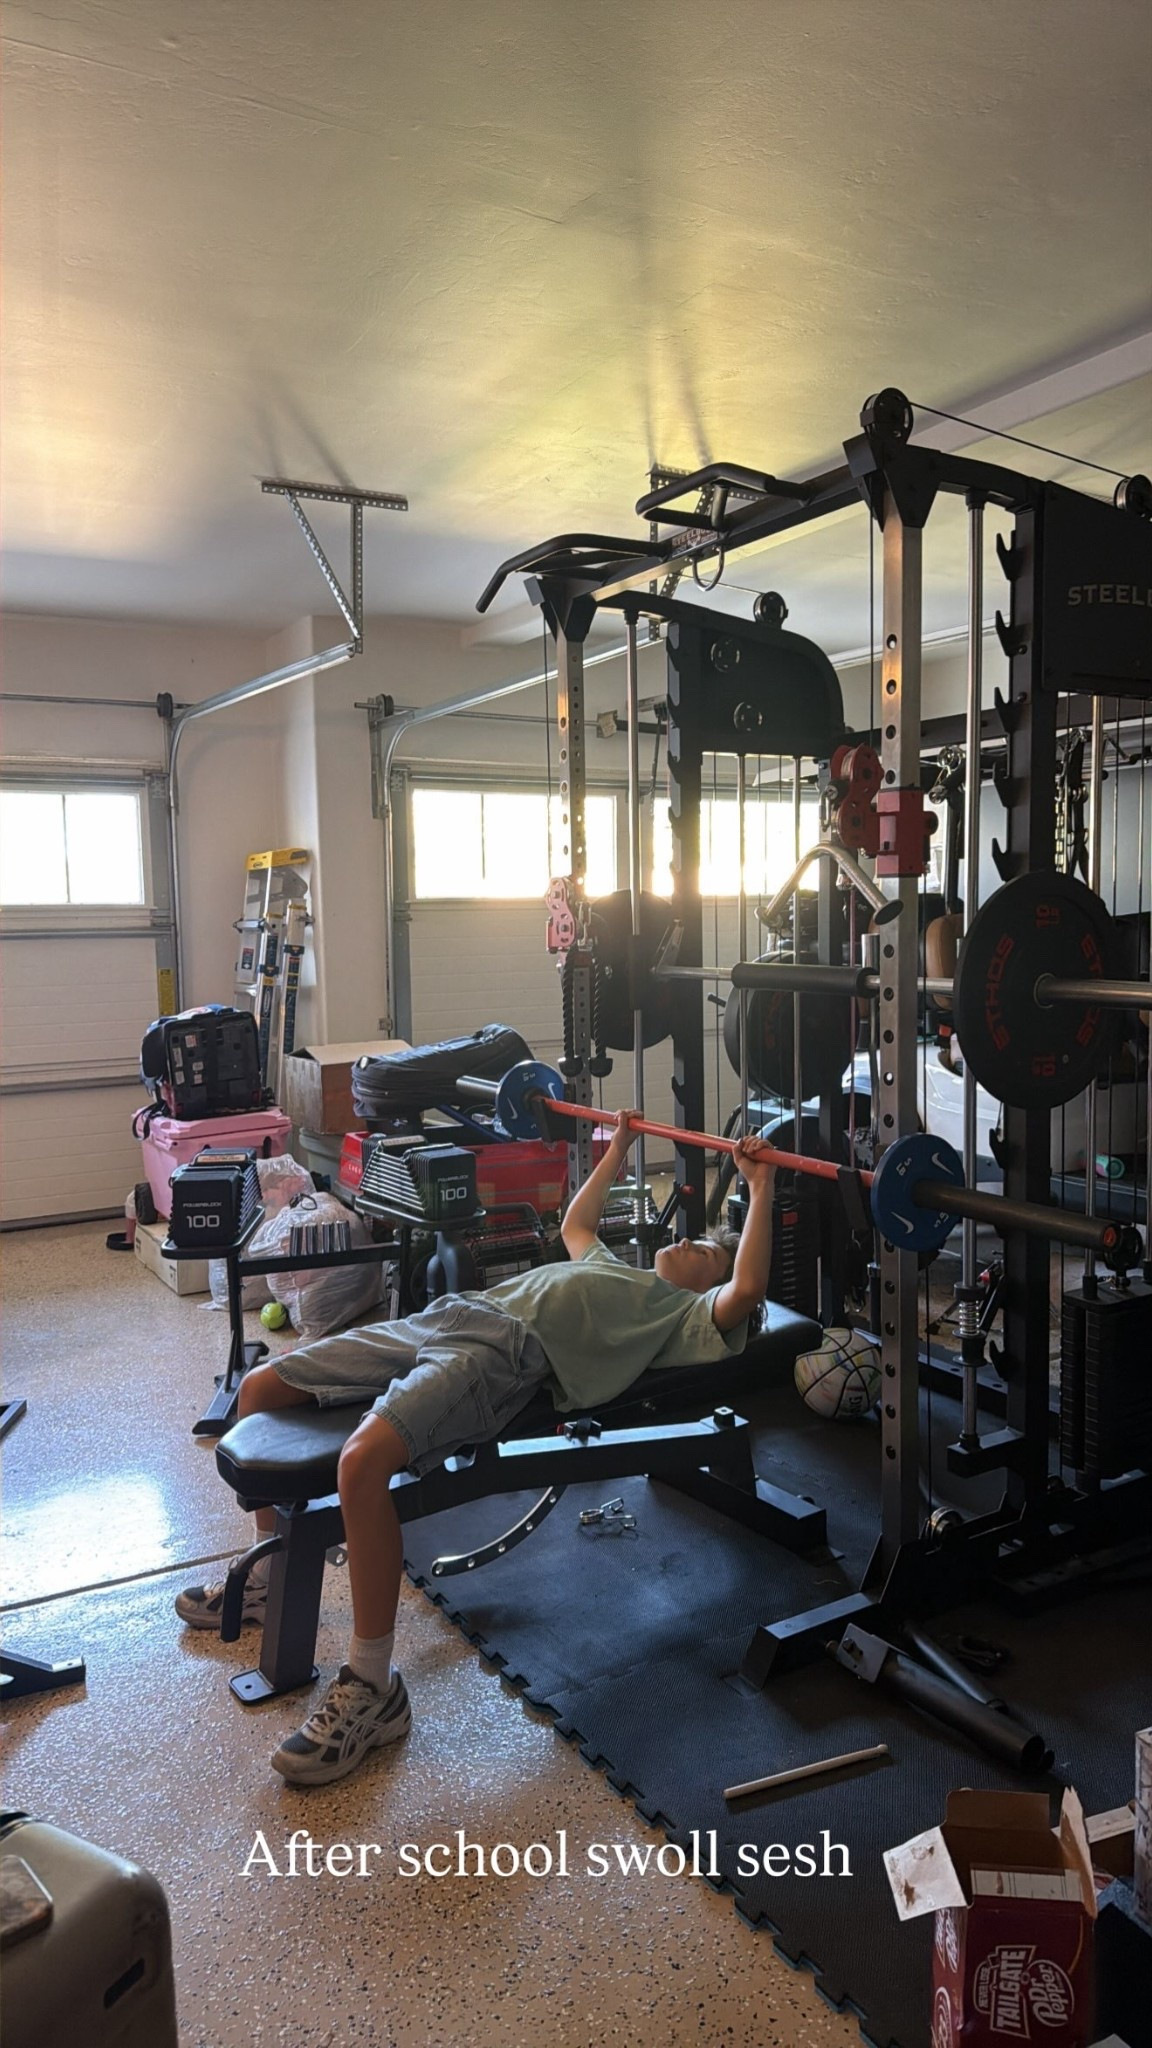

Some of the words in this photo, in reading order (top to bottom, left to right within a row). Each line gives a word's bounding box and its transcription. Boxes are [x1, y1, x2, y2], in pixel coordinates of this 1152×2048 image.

[986, 934, 1014, 1052] ETHOS
[440, 1186, 468, 1202] 100
[186, 1215, 221, 1229] 100
[996, 1950, 1027, 2029] TAILGATE
[1028, 1977, 1050, 2002] Dr
[1032, 1964, 1069, 2022] Pepper
